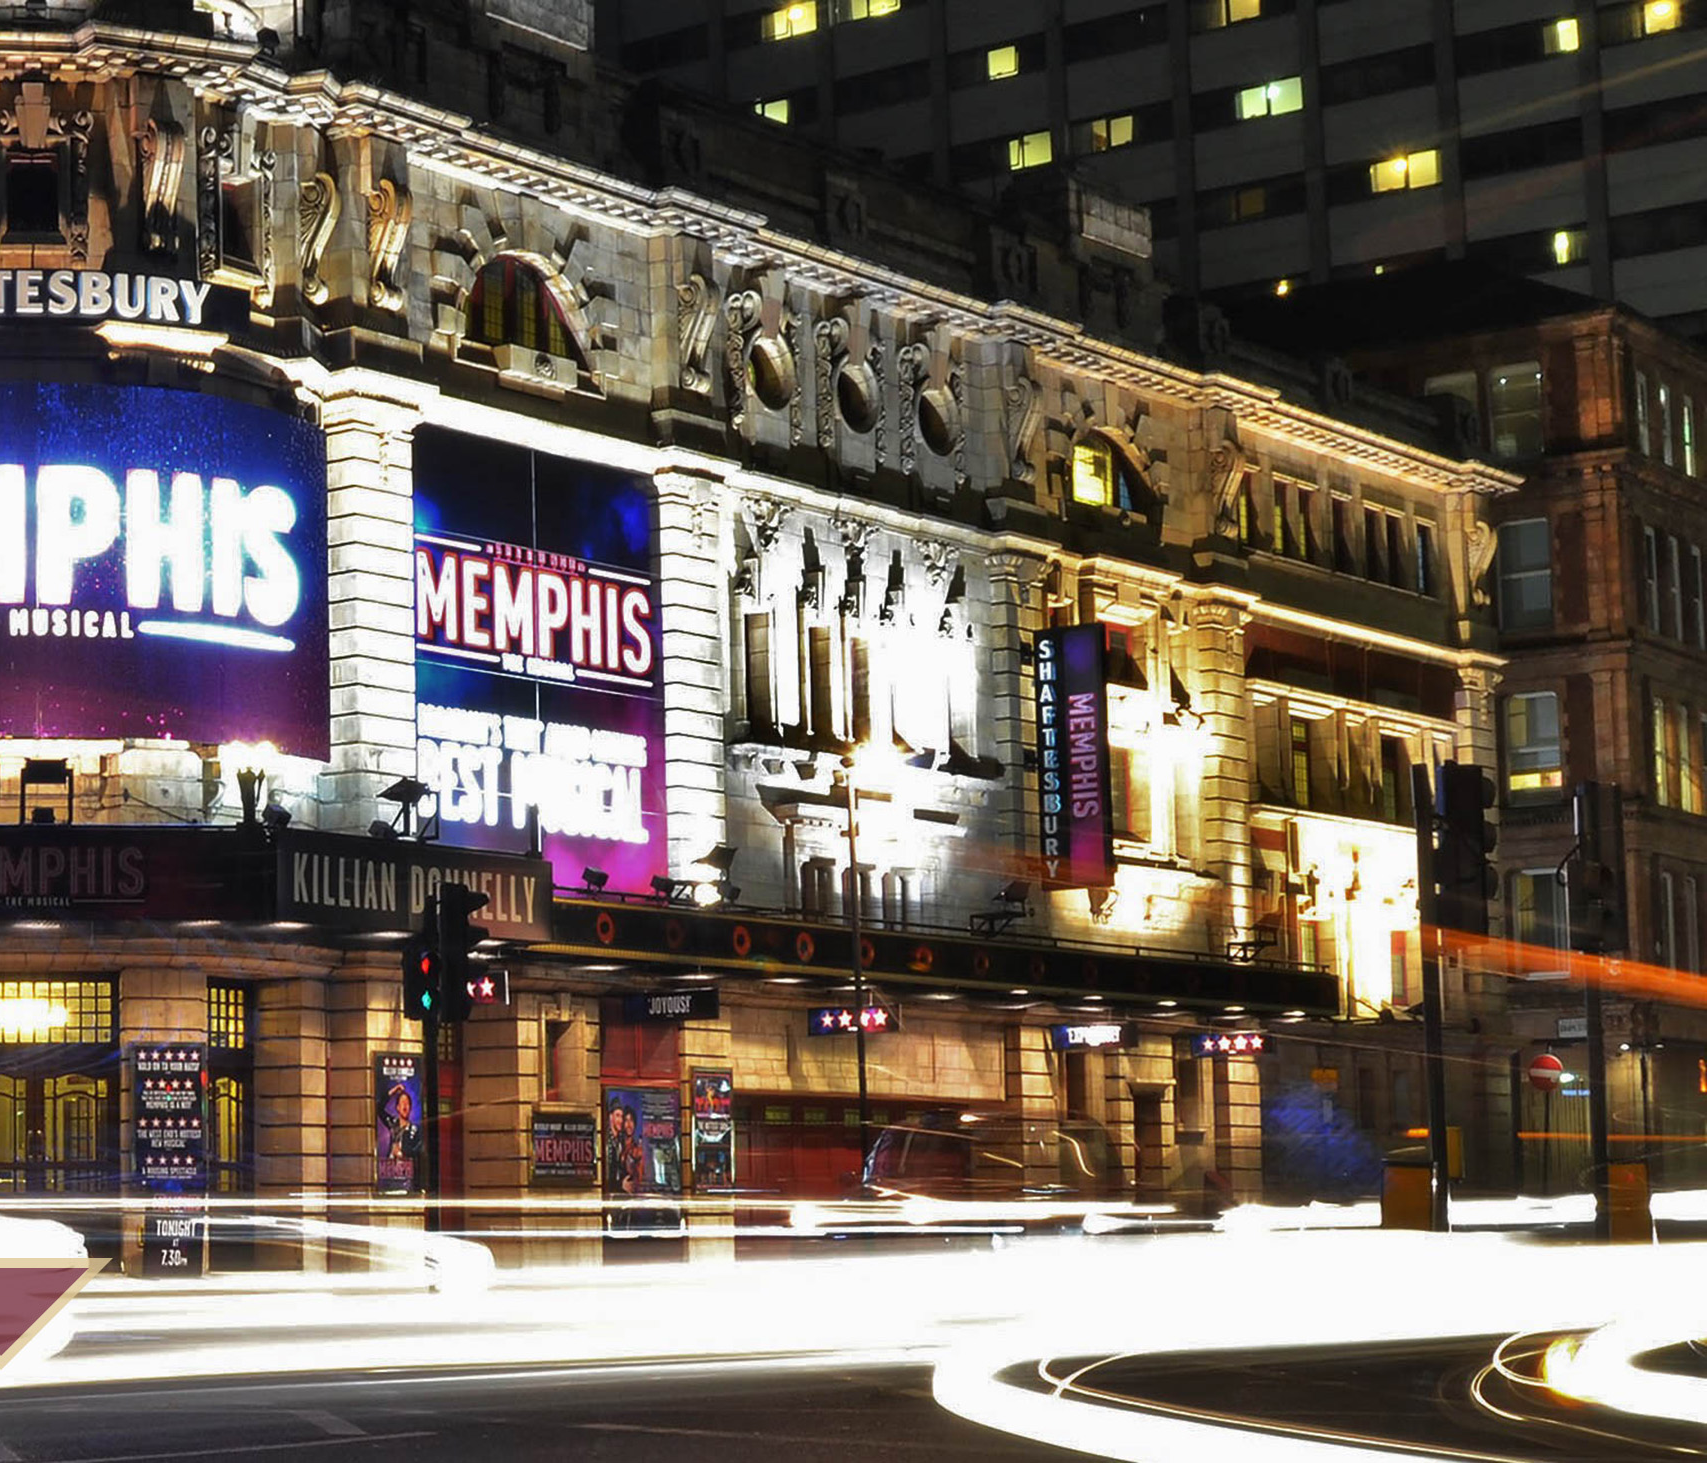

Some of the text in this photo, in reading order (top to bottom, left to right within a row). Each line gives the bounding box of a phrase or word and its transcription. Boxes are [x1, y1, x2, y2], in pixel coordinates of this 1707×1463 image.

[8, 608, 136, 639] MUSICAL
[413, 546, 655, 677] MEMPHIS
[1038, 639, 1062, 878] SHAFTESBURY
[1068, 692, 1099, 818] MEMPHIS
[294, 851, 396, 912] KILLIAN
[535, 1139, 592, 1162] MEMPHIS
[156, 1220, 196, 1237] TONIGHT
